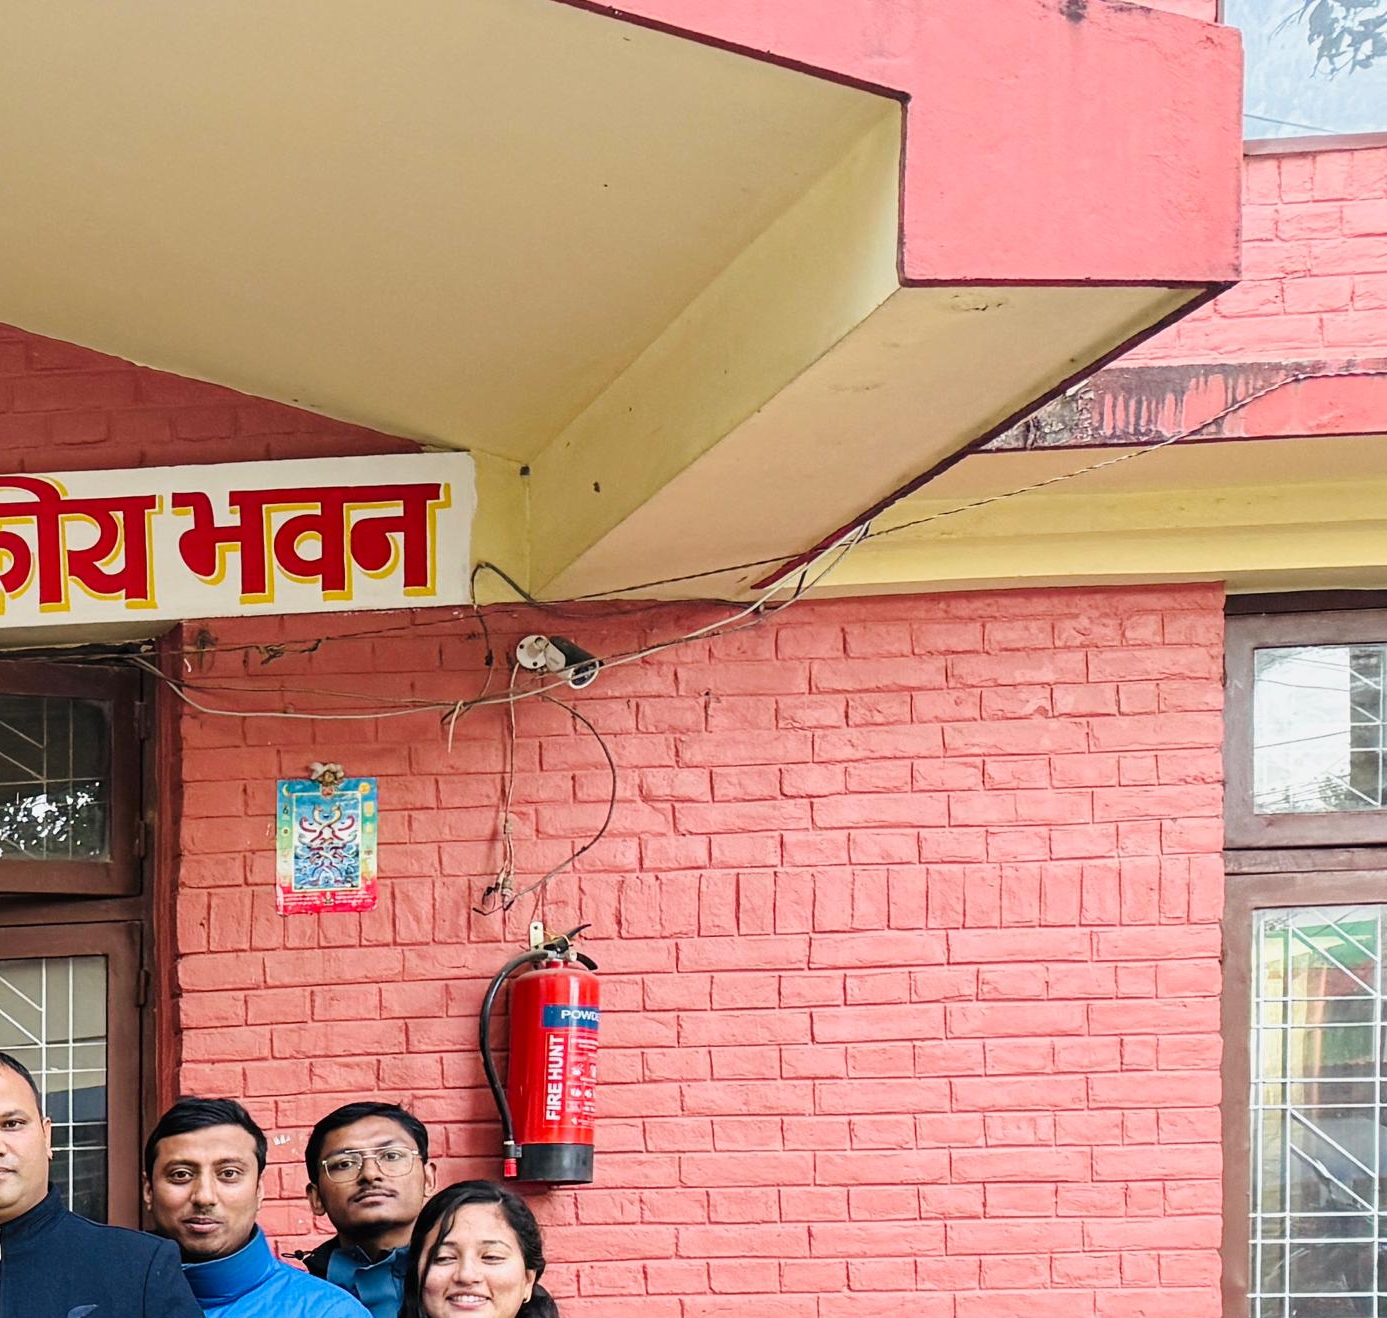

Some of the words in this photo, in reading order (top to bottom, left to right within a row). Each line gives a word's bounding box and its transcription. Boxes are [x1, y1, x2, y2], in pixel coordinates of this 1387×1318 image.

[171, 483, 451, 605] भवन
[548, 1034, 565, 1081] HUNT
[546, 1083, 563, 1121] FIRE
